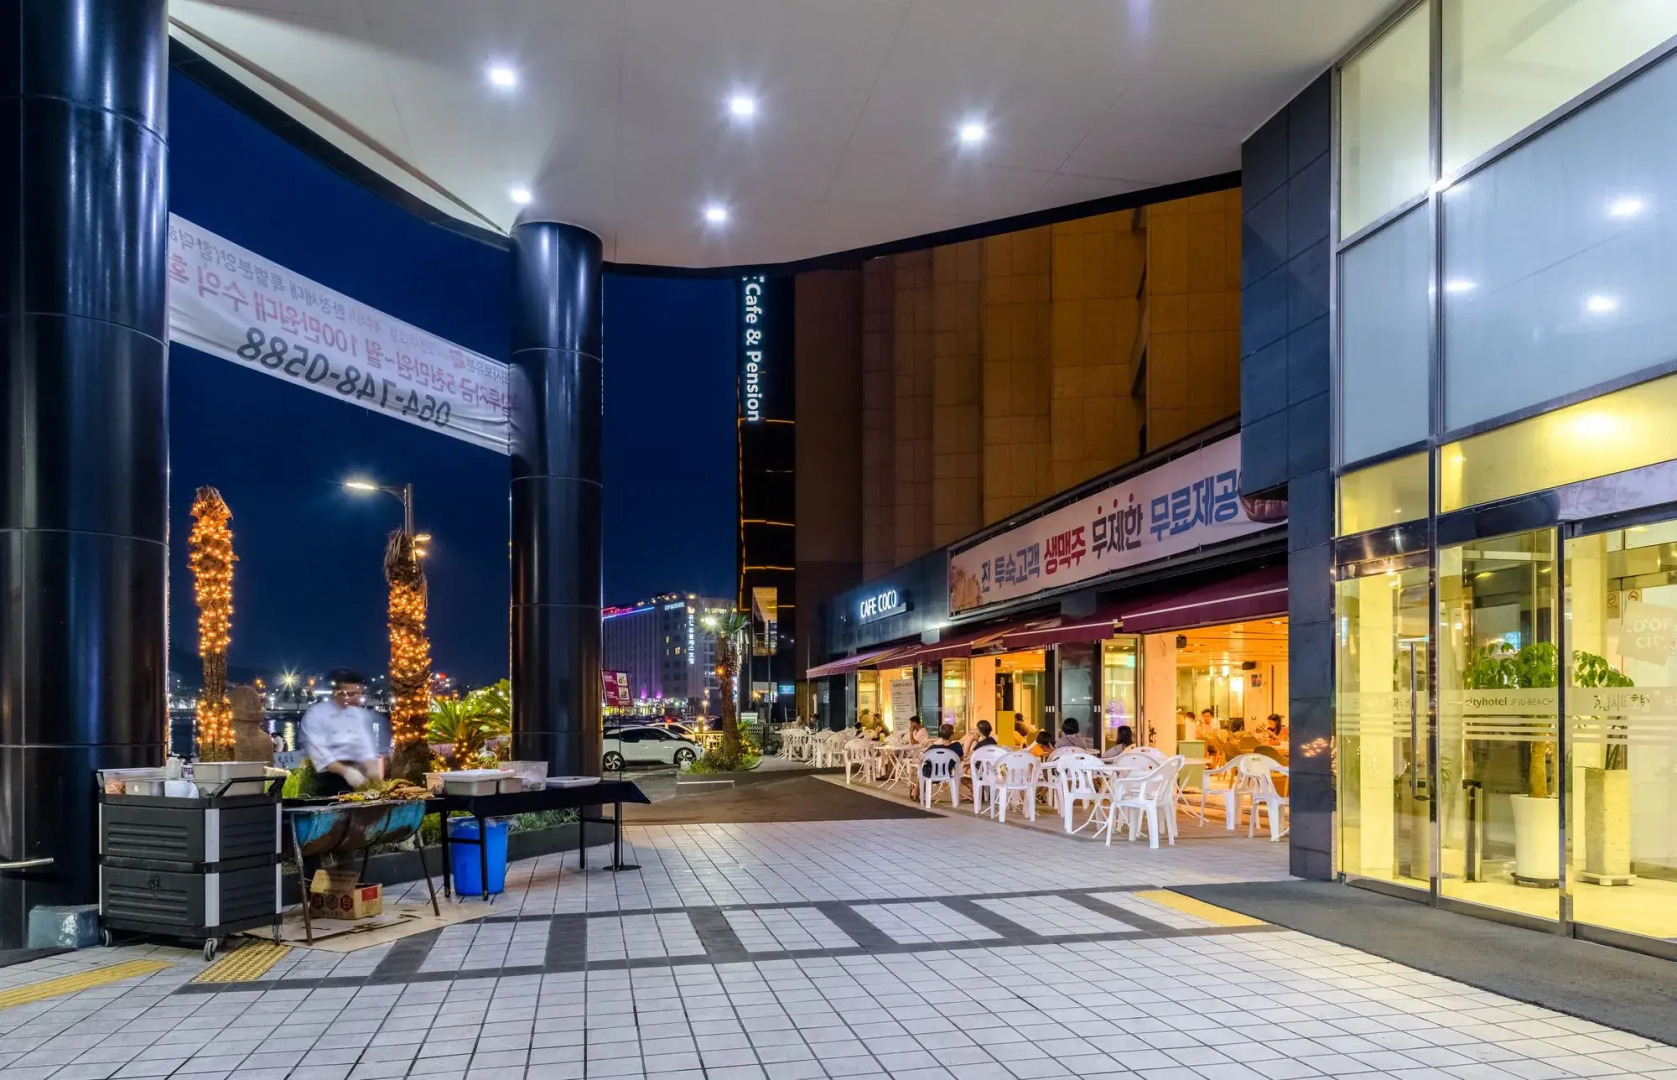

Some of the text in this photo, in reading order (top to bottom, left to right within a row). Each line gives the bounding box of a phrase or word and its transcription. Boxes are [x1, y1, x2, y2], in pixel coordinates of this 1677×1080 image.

[744, 283, 763, 324] Cafe
[745, 328, 762, 346] &
[746, 351, 763, 422] Pension
[980, 467, 1240, 594] 전 투숙고객 생맥주 무제한 무료제공
[859, 589, 897, 618] CAFE COCO
[1464, 697, 1508, 709] cityhotel
